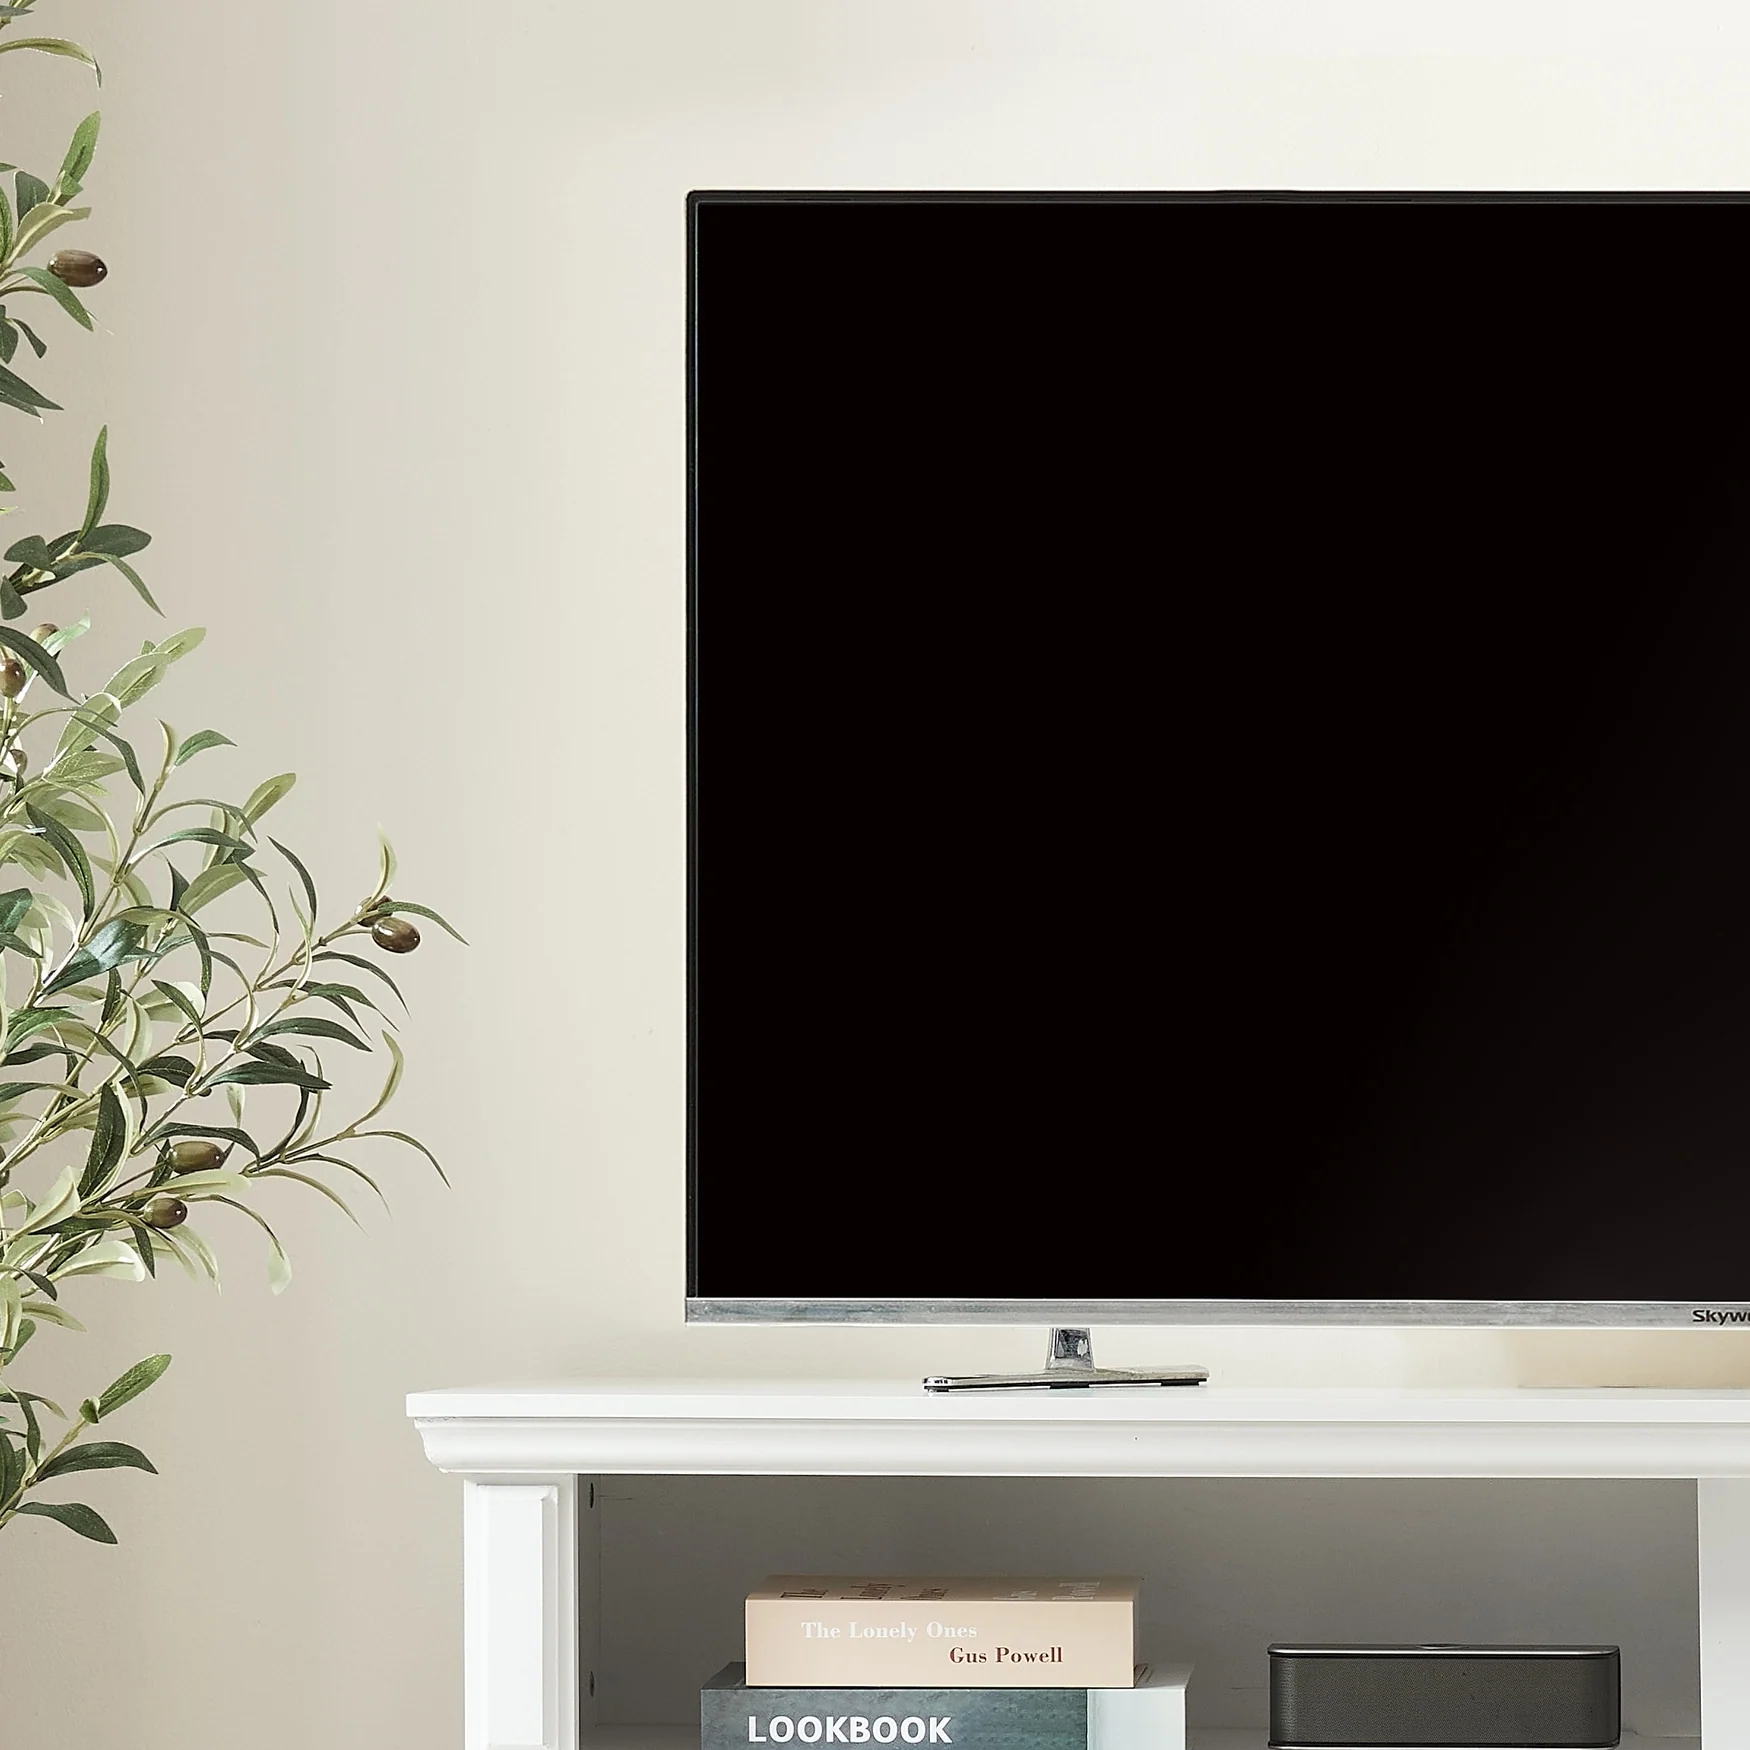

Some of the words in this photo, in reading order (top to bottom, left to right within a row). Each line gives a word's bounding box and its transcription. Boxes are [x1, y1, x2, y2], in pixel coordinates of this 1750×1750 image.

[801, 1621, 841, 1639] The
[849, 1621, 917, 1642] Lonely
[926, 1621, 978, 1639] Ones
[949, 1646, 987, 1663] Gus
[995, 1646, 1063, 1663] Powell
[748, 1715, 953, 1744] LOOKBOOK
